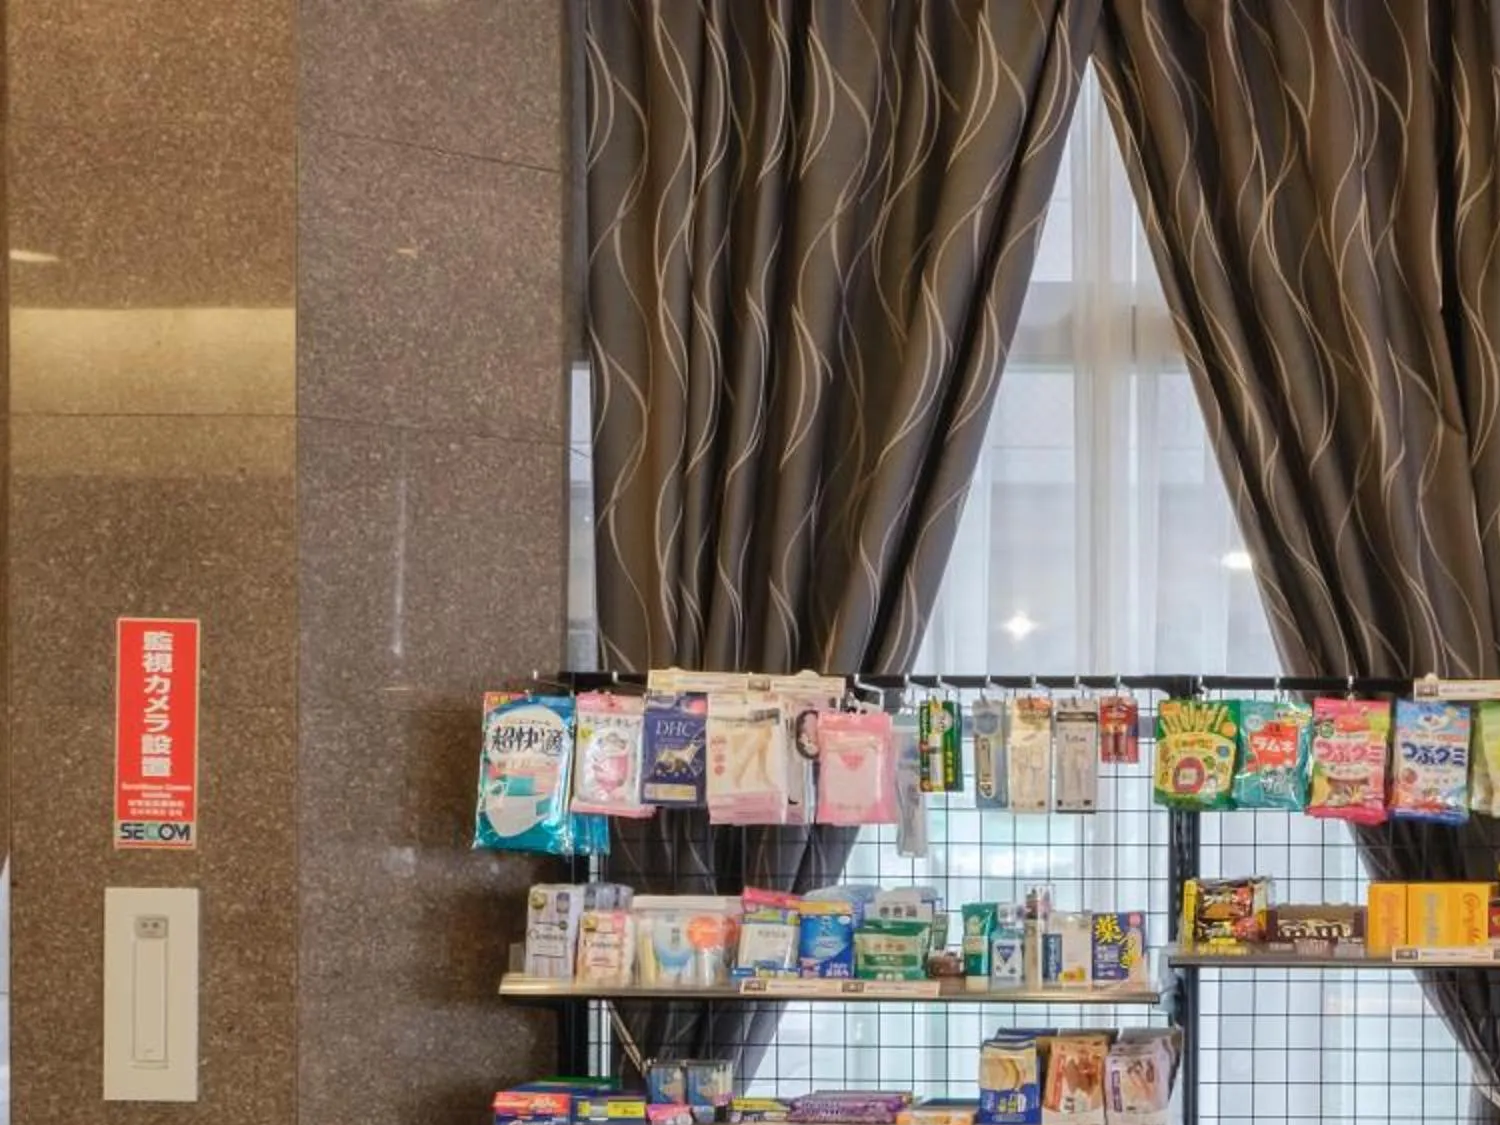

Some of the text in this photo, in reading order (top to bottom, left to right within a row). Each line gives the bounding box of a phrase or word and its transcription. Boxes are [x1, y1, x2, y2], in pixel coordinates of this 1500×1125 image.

[141, 630, 174, 777] 監視カメラ設置
[491, 726, 563, 751] 超快適
[655, 719, 696, 737] DHC
[1251, 737, 1296, 752] ラムネ
[1315, 739, 1384, 763] つぶグミ
[1400, 741, 1467, 767] つぶグミ
[120, 822, 190, 841] SECOM
